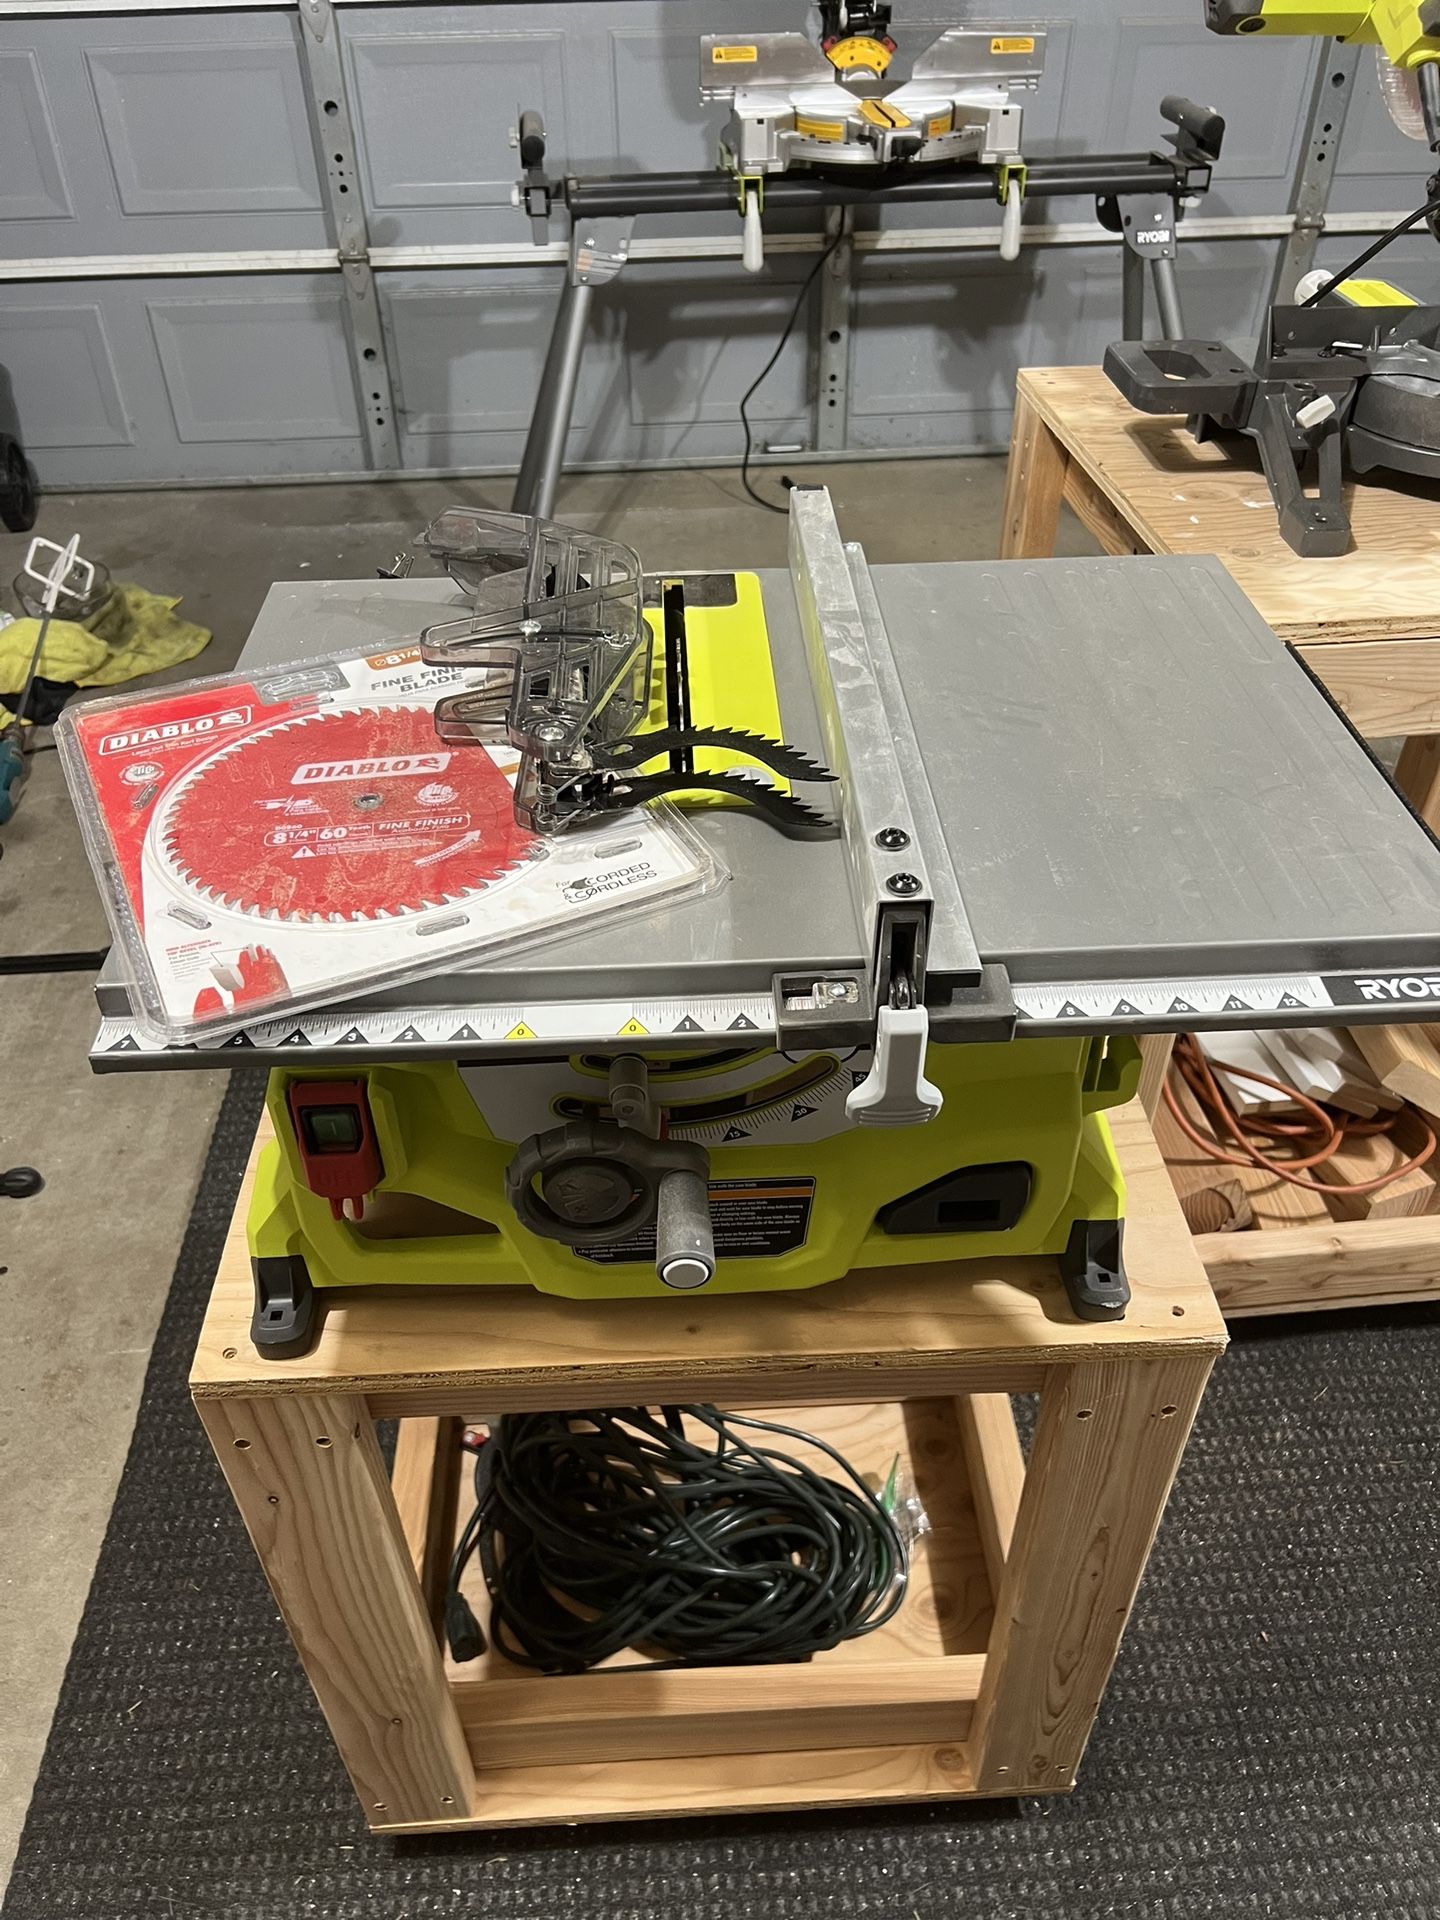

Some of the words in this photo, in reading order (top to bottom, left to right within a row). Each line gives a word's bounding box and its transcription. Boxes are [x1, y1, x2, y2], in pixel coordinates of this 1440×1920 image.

[1137, 230, 1170, 243] RYOBI
[371, 675, 414, 691] FINE
[420, 666, 468, 680] FINI
[400, 672, 464, 693] BLADE
[109, 718, 214, 750] DIABLO
[303, 760, 411, 779] DIABLO
[320, 827, 348, 840] 60
[378, 822, 411, 830] FINE
[415, 816, 463, 827] FINISH
[555, 880, 571, 888] For
[574, 870, 658, 899] CORDLESS
[586, 862, 651, 886] CORDED
[1353, 977, 1440, 1000] RYO
[1066, 1006, 1076, 1015] 8
[1121, 1004, 1130, 1013] 9
[1173, 1002, 1189, 1012] 10
[1228, 1000, 1243, 1009] 11
[1283, 997, 1299, 1006] 12
[119, 1040, 131, 1049] 7
[233, 1036, 243, 1045] 5
[290, 1034, 300, 1044] 4
[347, 1033, 357, 1042] 3
[404, 1031, 414, 1040] 2
[462, 1029, 469, 1038] 1
[517, 1028, 525, 1036] 0
[629, 1024, 636, 1032] 0
[684, 1021, 690, 1029] 1
[738, 1019, 746, 1028] 2
[795, 1108, 808, 1117] 30
[729, 1130, 741, 1138] 15
